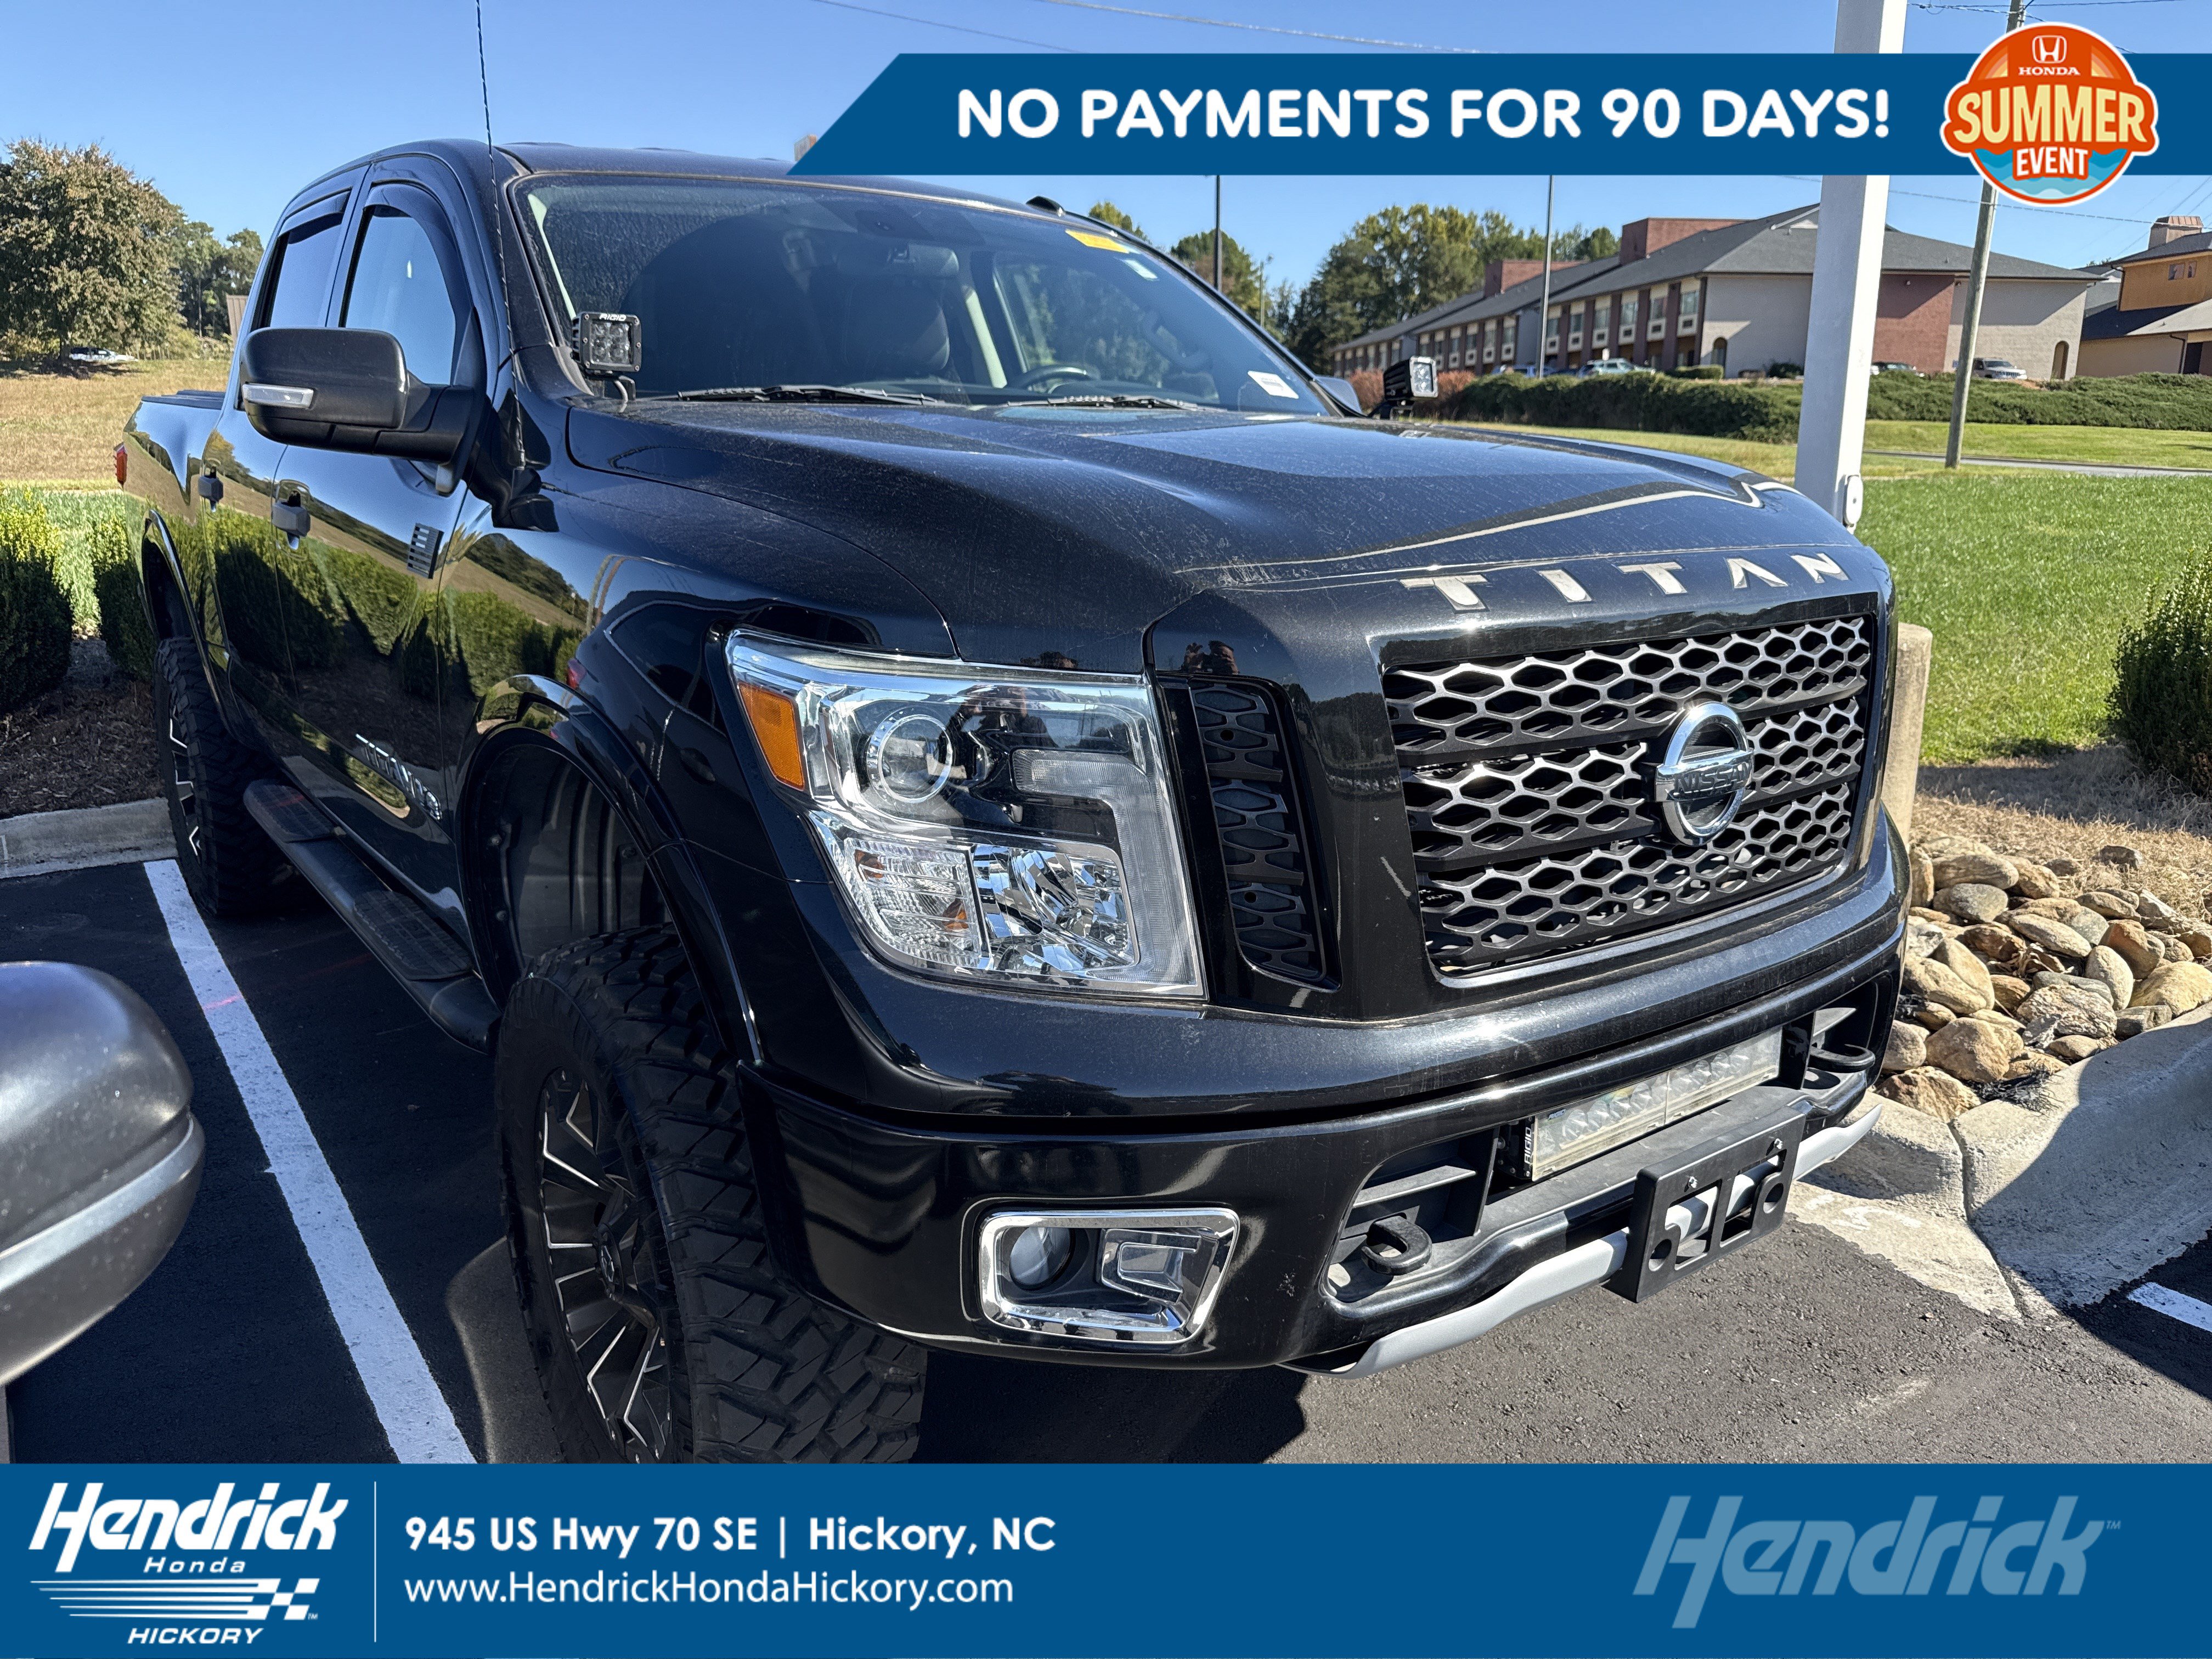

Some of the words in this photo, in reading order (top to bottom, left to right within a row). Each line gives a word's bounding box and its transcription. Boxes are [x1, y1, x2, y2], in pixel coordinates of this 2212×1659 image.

[599, 313, 627, 321] RIGID
[1398, 552, 1849, 612] TITAN
[1673, 762, 1750, 794] NISSAN
